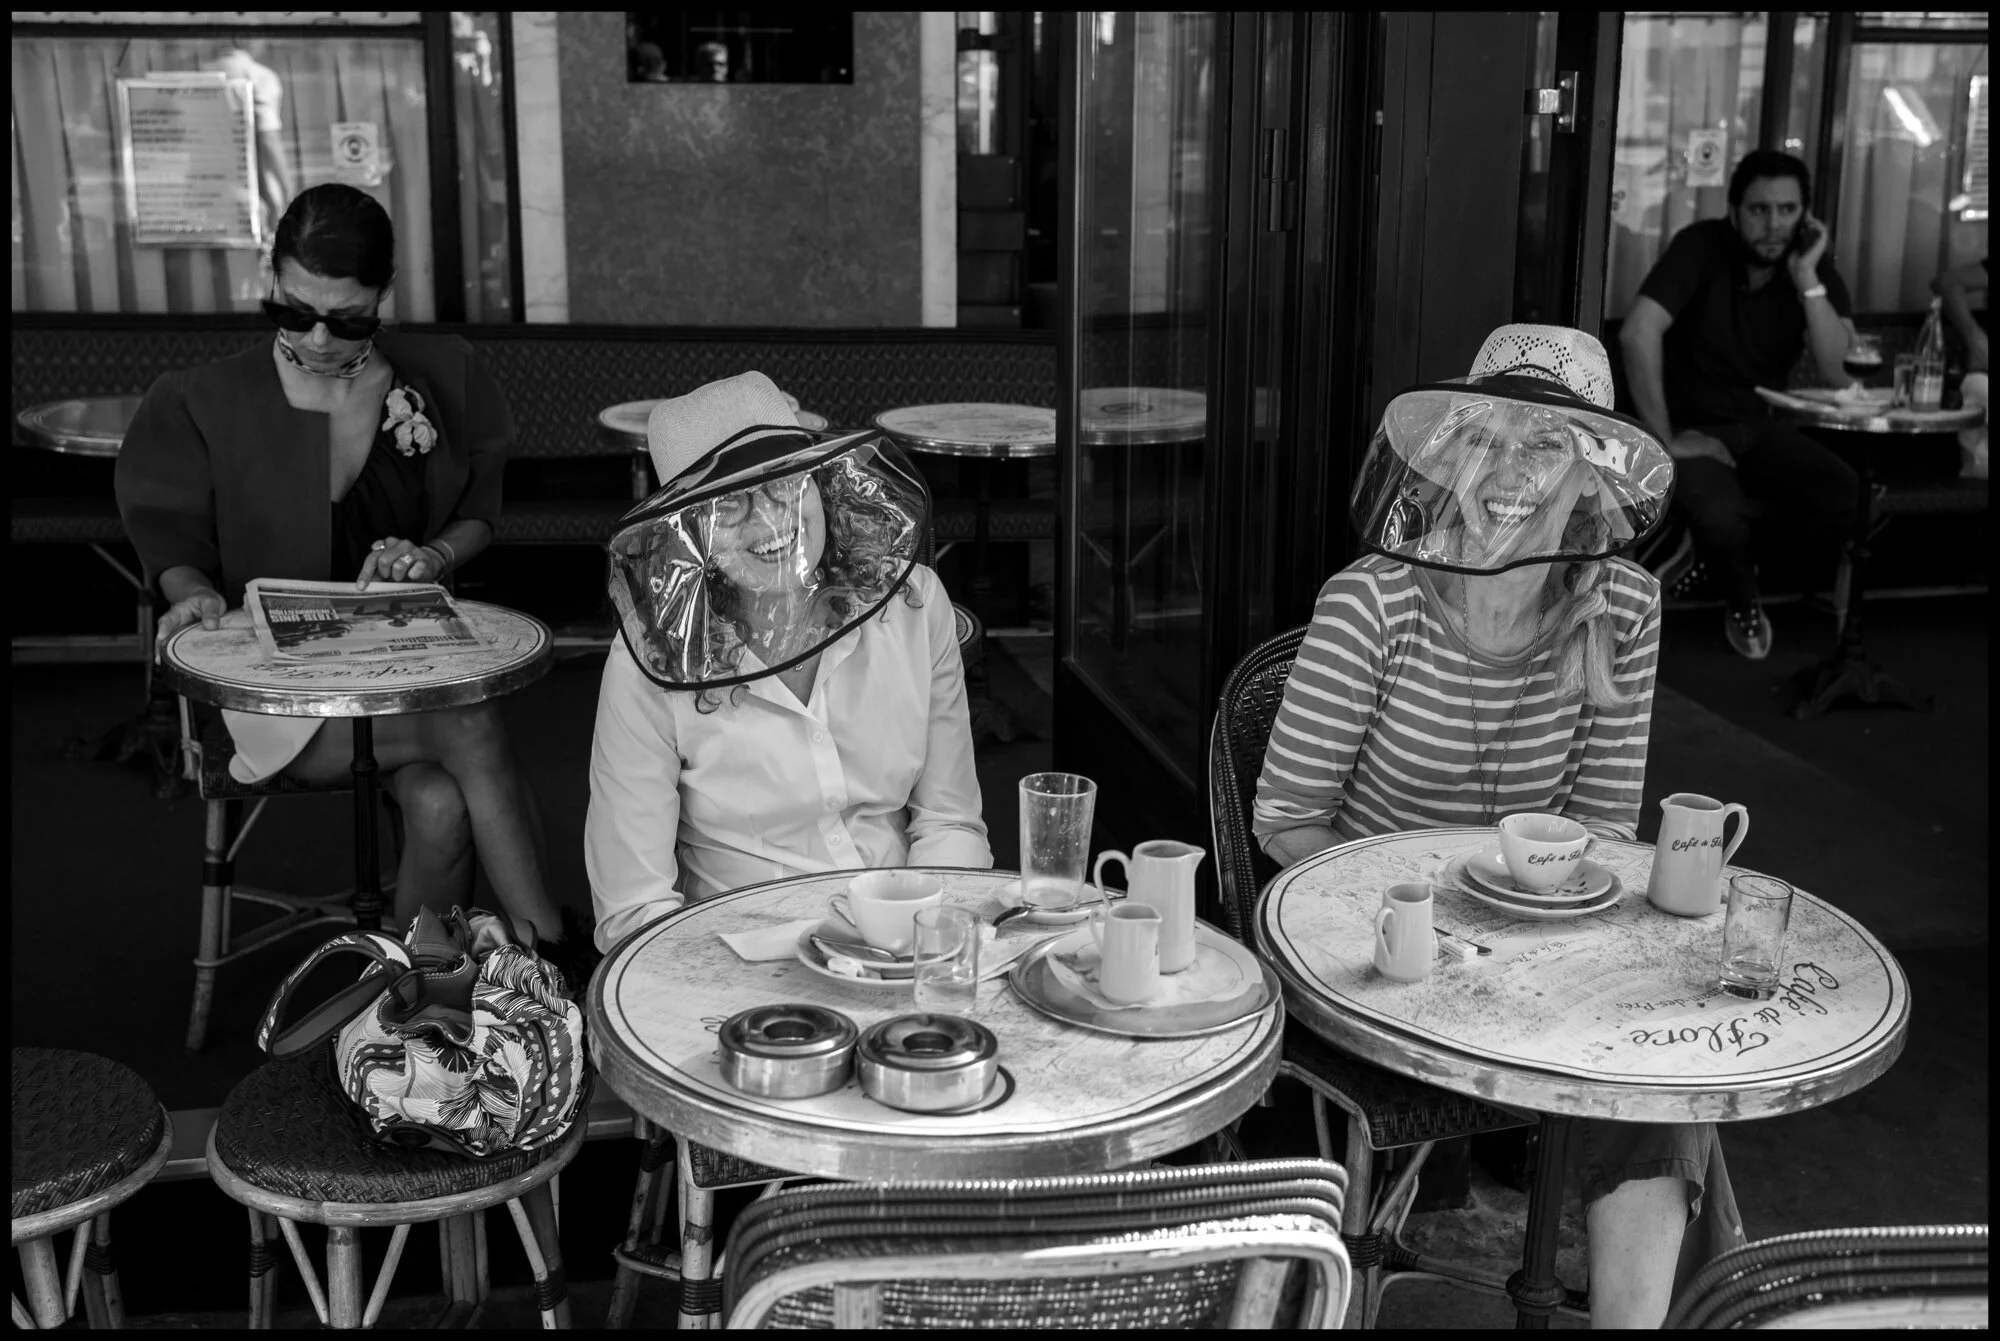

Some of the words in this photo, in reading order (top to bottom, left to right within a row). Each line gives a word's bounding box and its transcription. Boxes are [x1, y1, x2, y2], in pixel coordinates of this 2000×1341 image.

[1672, 836, 1699, 852] Café
[1527, 852, 1557, 865] Café
[1778, 961, 1839, 1015] Café
[1753, 1005, 1782, 1026] de
[1629, 1018, 1770, 1057] Flore
